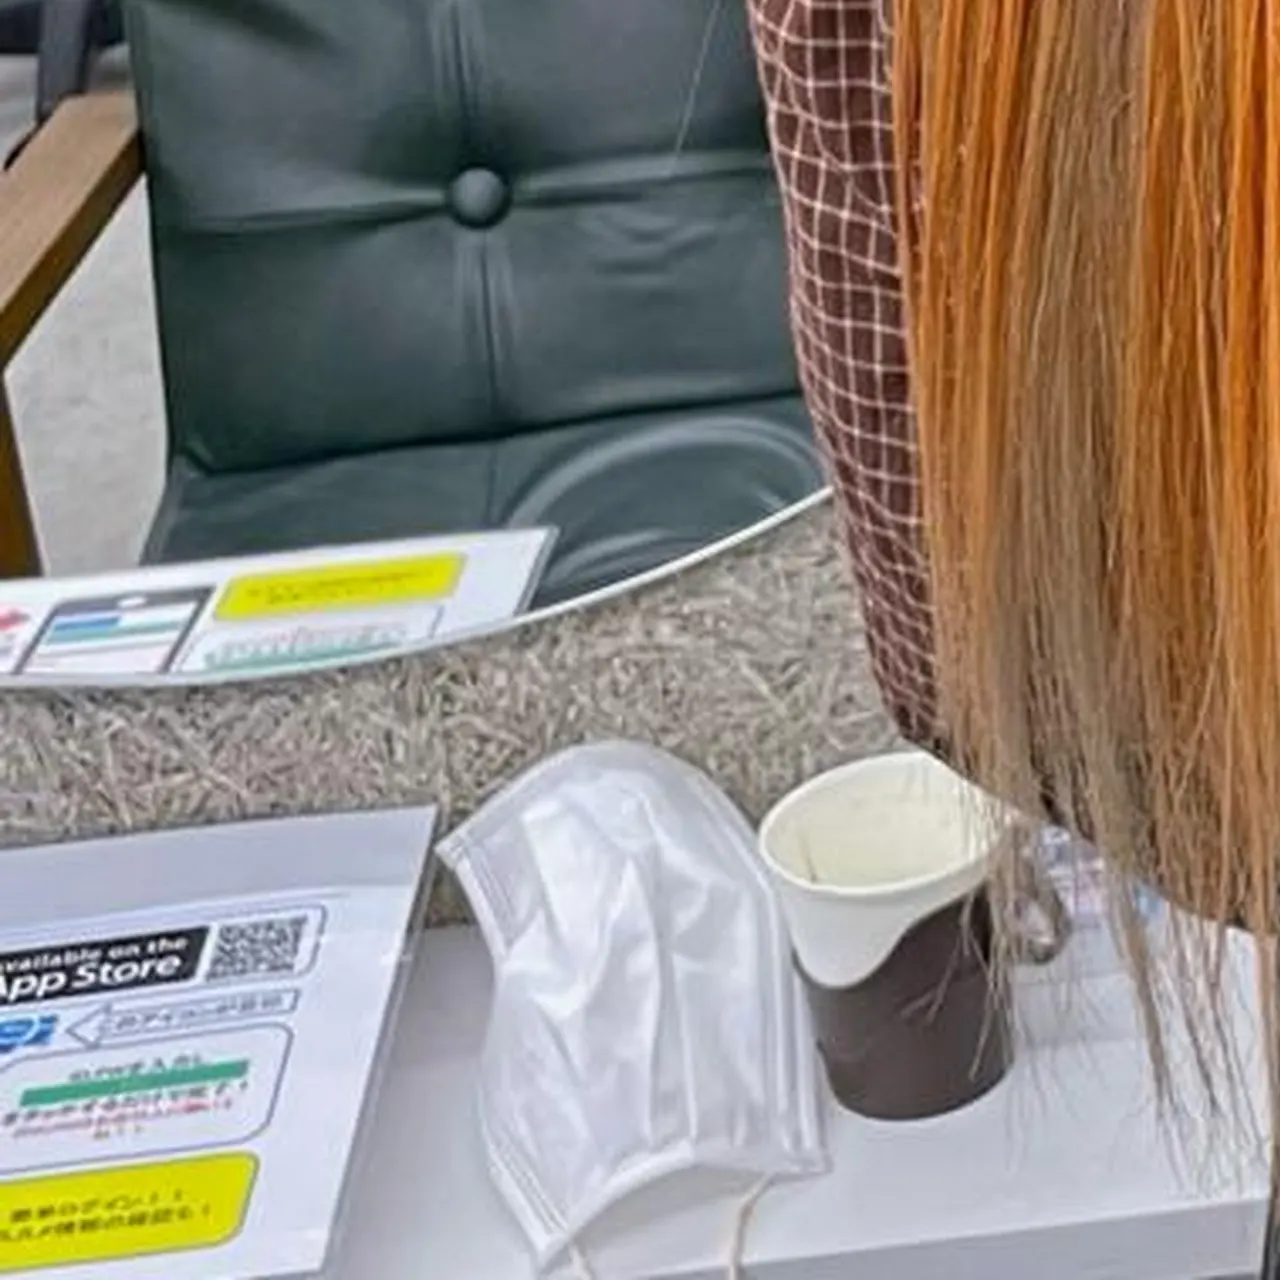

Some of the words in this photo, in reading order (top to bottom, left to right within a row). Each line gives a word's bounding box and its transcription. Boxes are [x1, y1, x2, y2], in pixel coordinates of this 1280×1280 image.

[0, 943, 102, 975] vailable
[107, 945, 141, 959] on
[148, 936, 188, 953] the
[71, 954, 182, 989] Store
